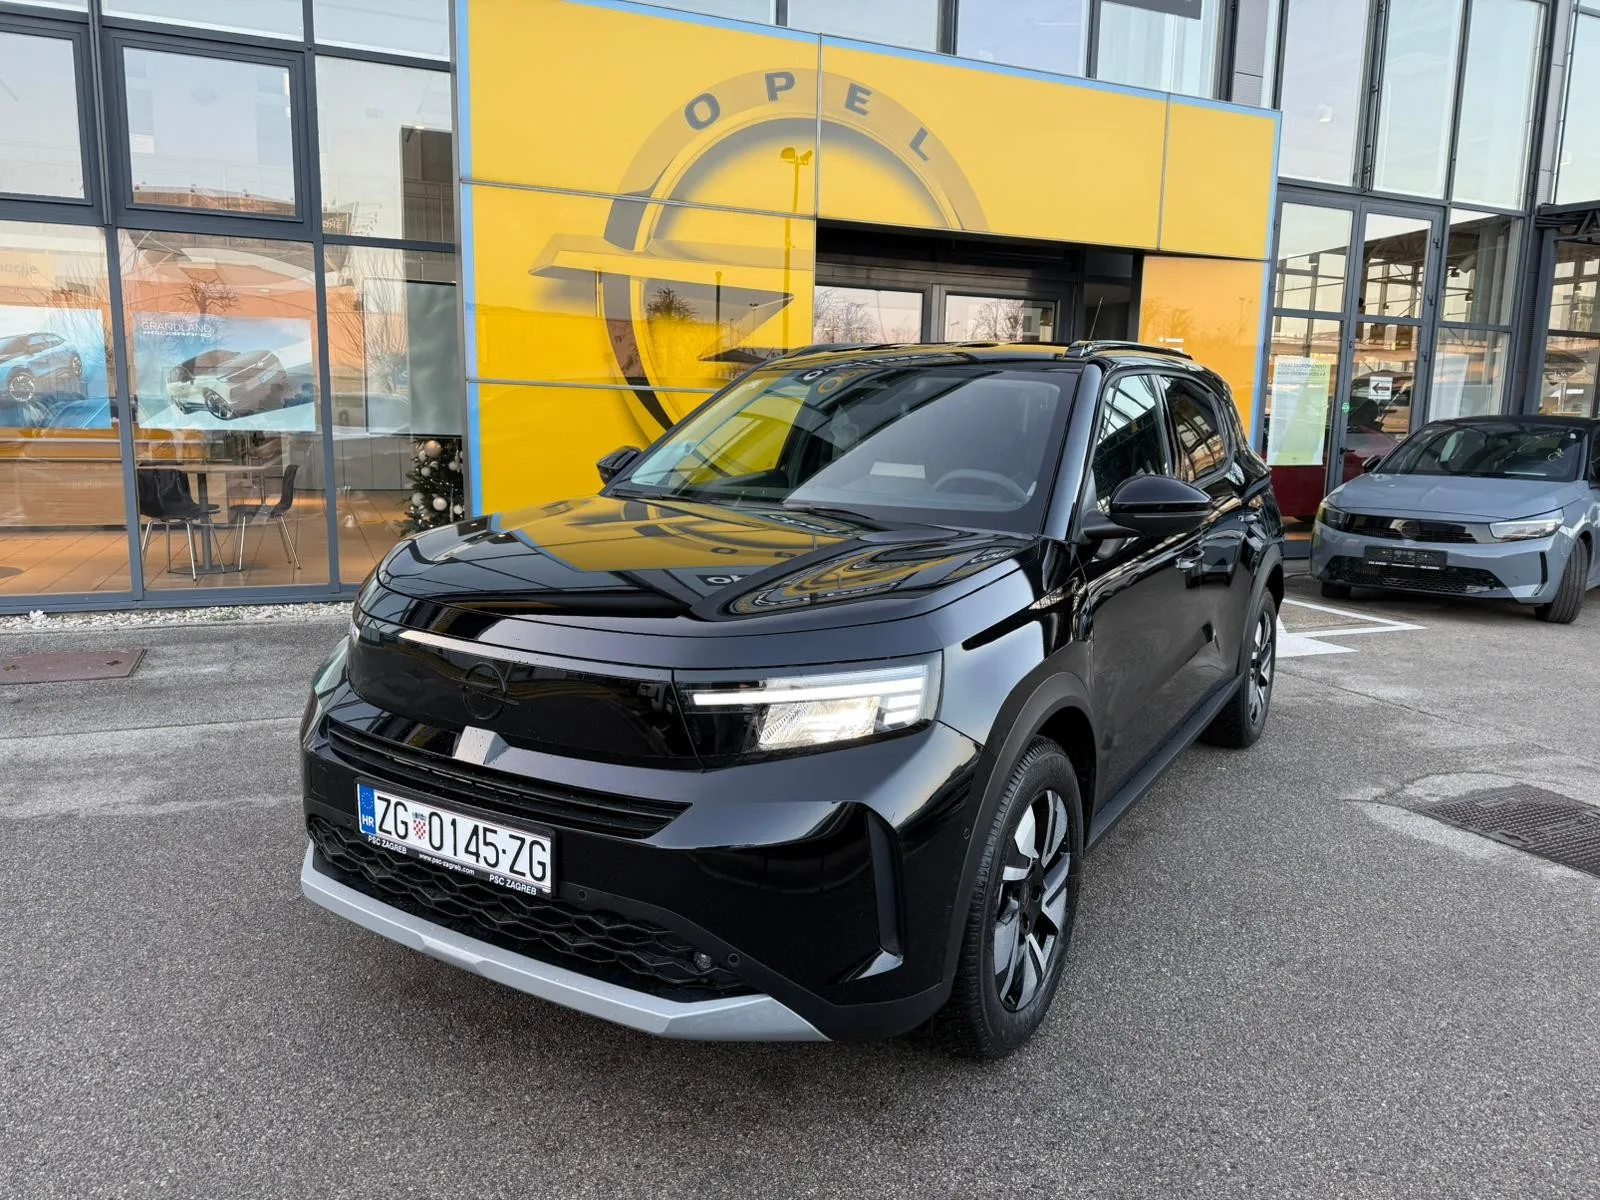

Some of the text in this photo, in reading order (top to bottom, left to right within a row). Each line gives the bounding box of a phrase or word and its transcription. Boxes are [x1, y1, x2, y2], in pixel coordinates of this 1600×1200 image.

[684, 71, 930, 162] OPEL
[141, 321, 212, 333] GRANDLAND
[361, 813, 375, 828] HR
[377, 795, 408, 840] ZG
[368, 835, 407, 855] PSC ZAGREB
[418, 853, 475, 876] www.psc-zagreb.com
[489, 874, 537, 896] PSC ZAGREB
